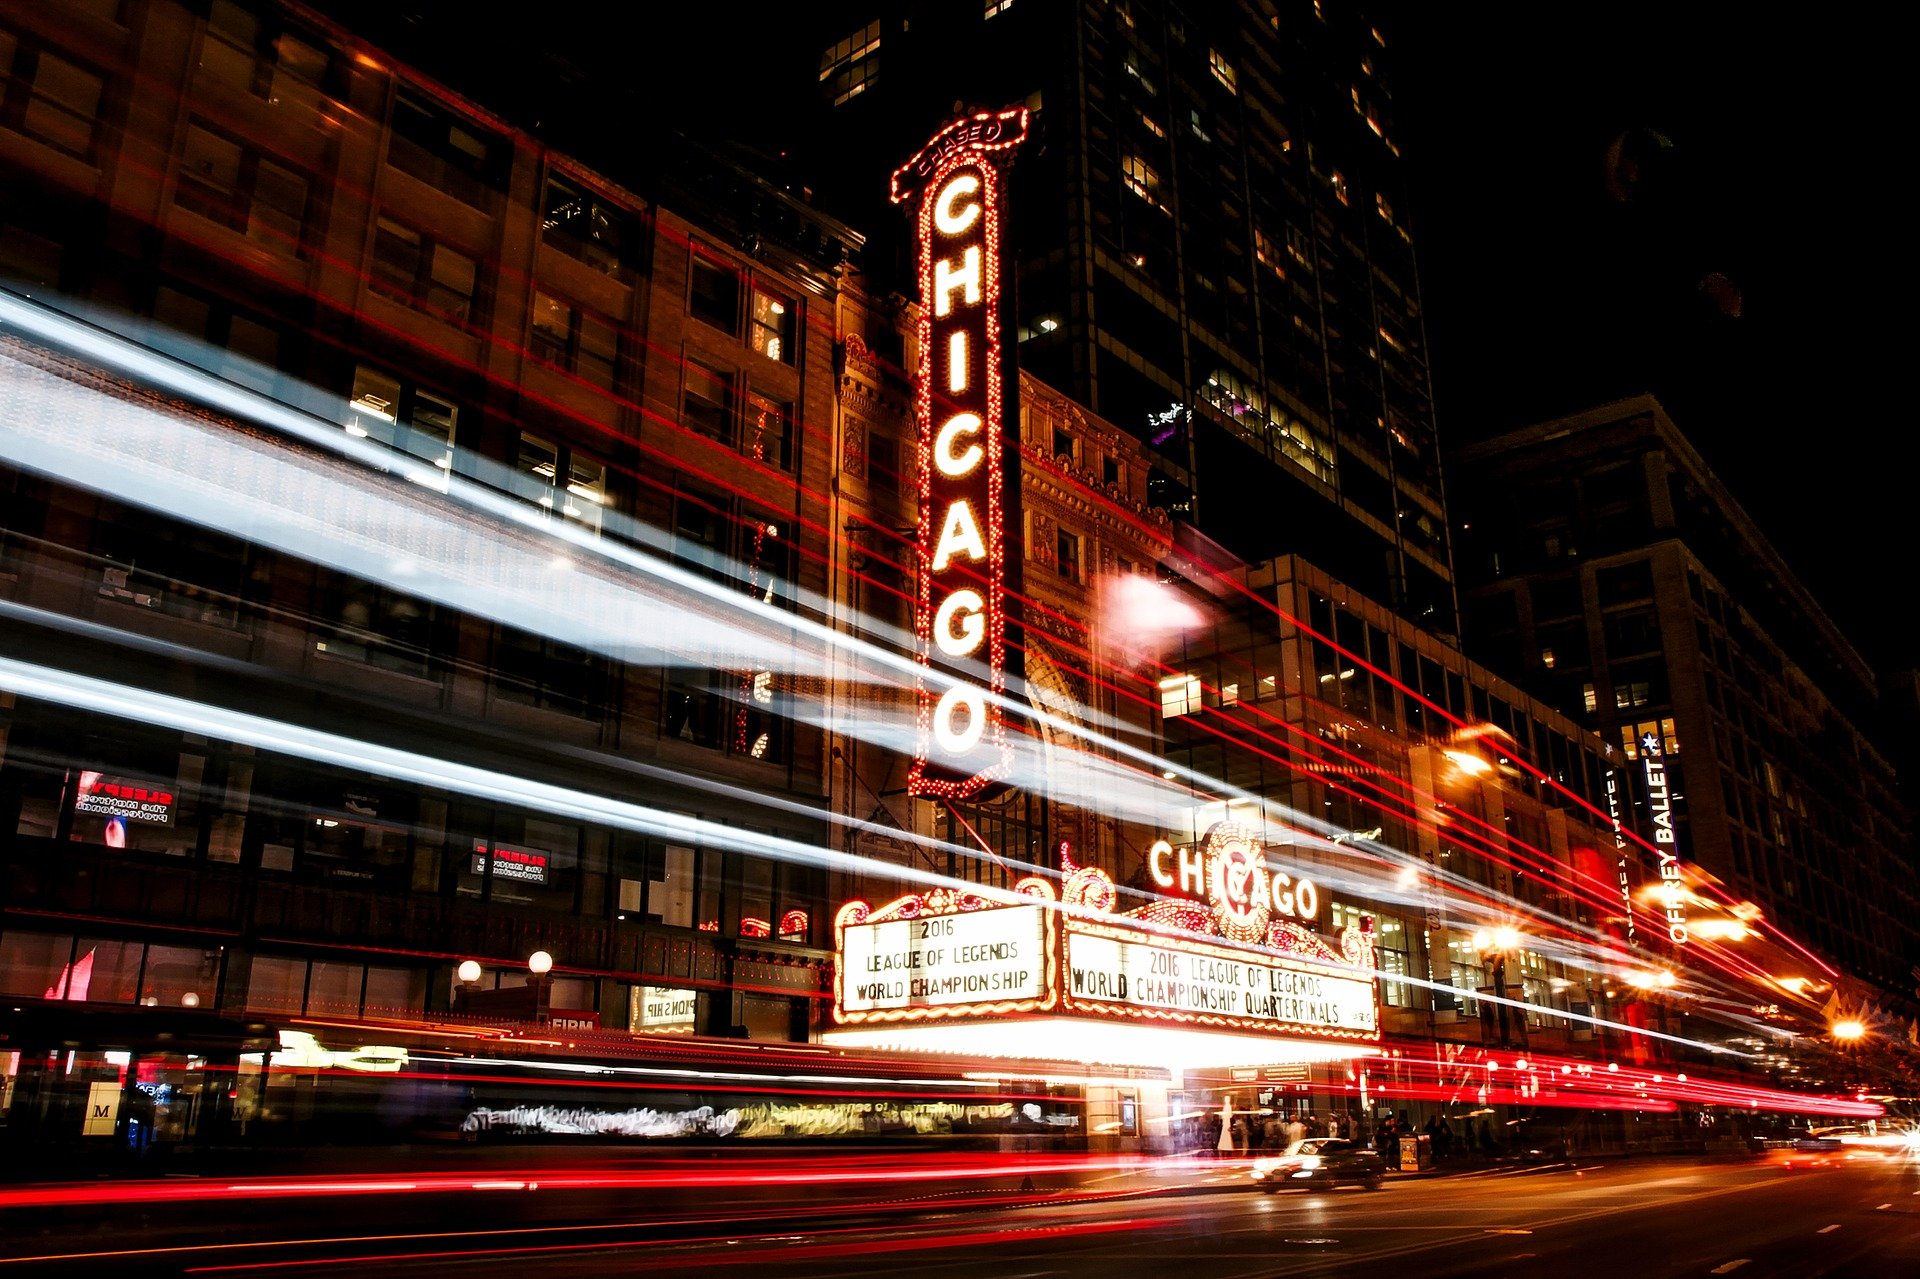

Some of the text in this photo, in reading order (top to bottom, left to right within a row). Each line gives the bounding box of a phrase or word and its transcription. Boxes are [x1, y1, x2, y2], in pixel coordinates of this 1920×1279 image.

[933, 174, 986, 754] CHICAGO
[1645, 757, 1675, 844] BALLET
[1150, 840, 1318, 919] CHICAGO
[921, 919, 954, 939] 2016
[867, 941, 1018, 972] LEAGUE OF LEGENDS
[1150, 951, 1323, 998] 2016 LEAGUE OF LEGENDS
[857, 970, 1028, 1000] WORLD CHAMPIONSHIP
[1072, 967, 1339, 1024] WORLD CHAMPIONSHIP QUARTERFINALS
[94, 1105, 110, 1118] M
